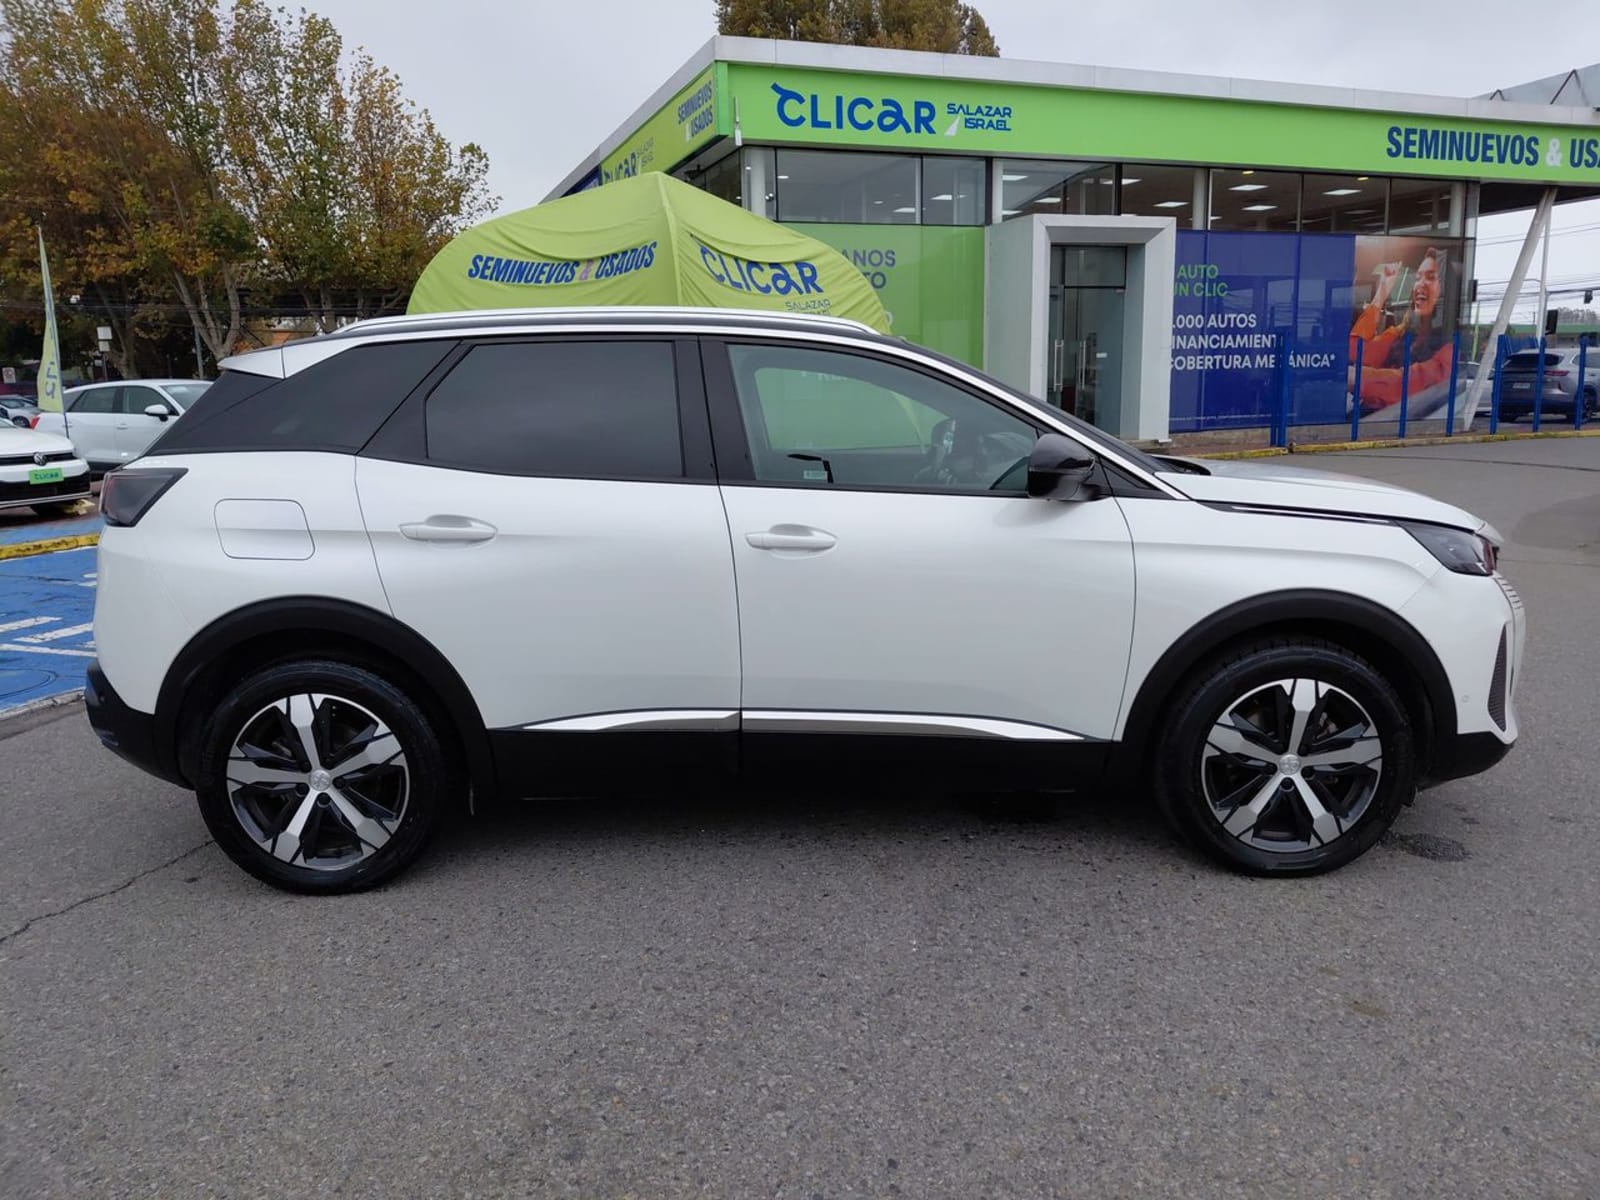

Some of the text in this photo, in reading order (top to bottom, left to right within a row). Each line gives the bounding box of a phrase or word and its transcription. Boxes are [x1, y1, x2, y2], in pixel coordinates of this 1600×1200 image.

[946, 103, 1012, 118] SALAZAR
[964, 118, 1012, 131] ISRAEL
[1386, 126, 1600, 168] SEMINUEVOS & US
[468, 254, 581, 284] SEMINUEVOS
[594, 241, 658, 280] USADOS
[1176, 264, 1219, 279] AUTO
[1193, 282, 1229, 297] CLIC
[1207, 313, 1257, 328] AUTOS
[1170, 350, 1336, 370] OBERTURA MEÁNICA
